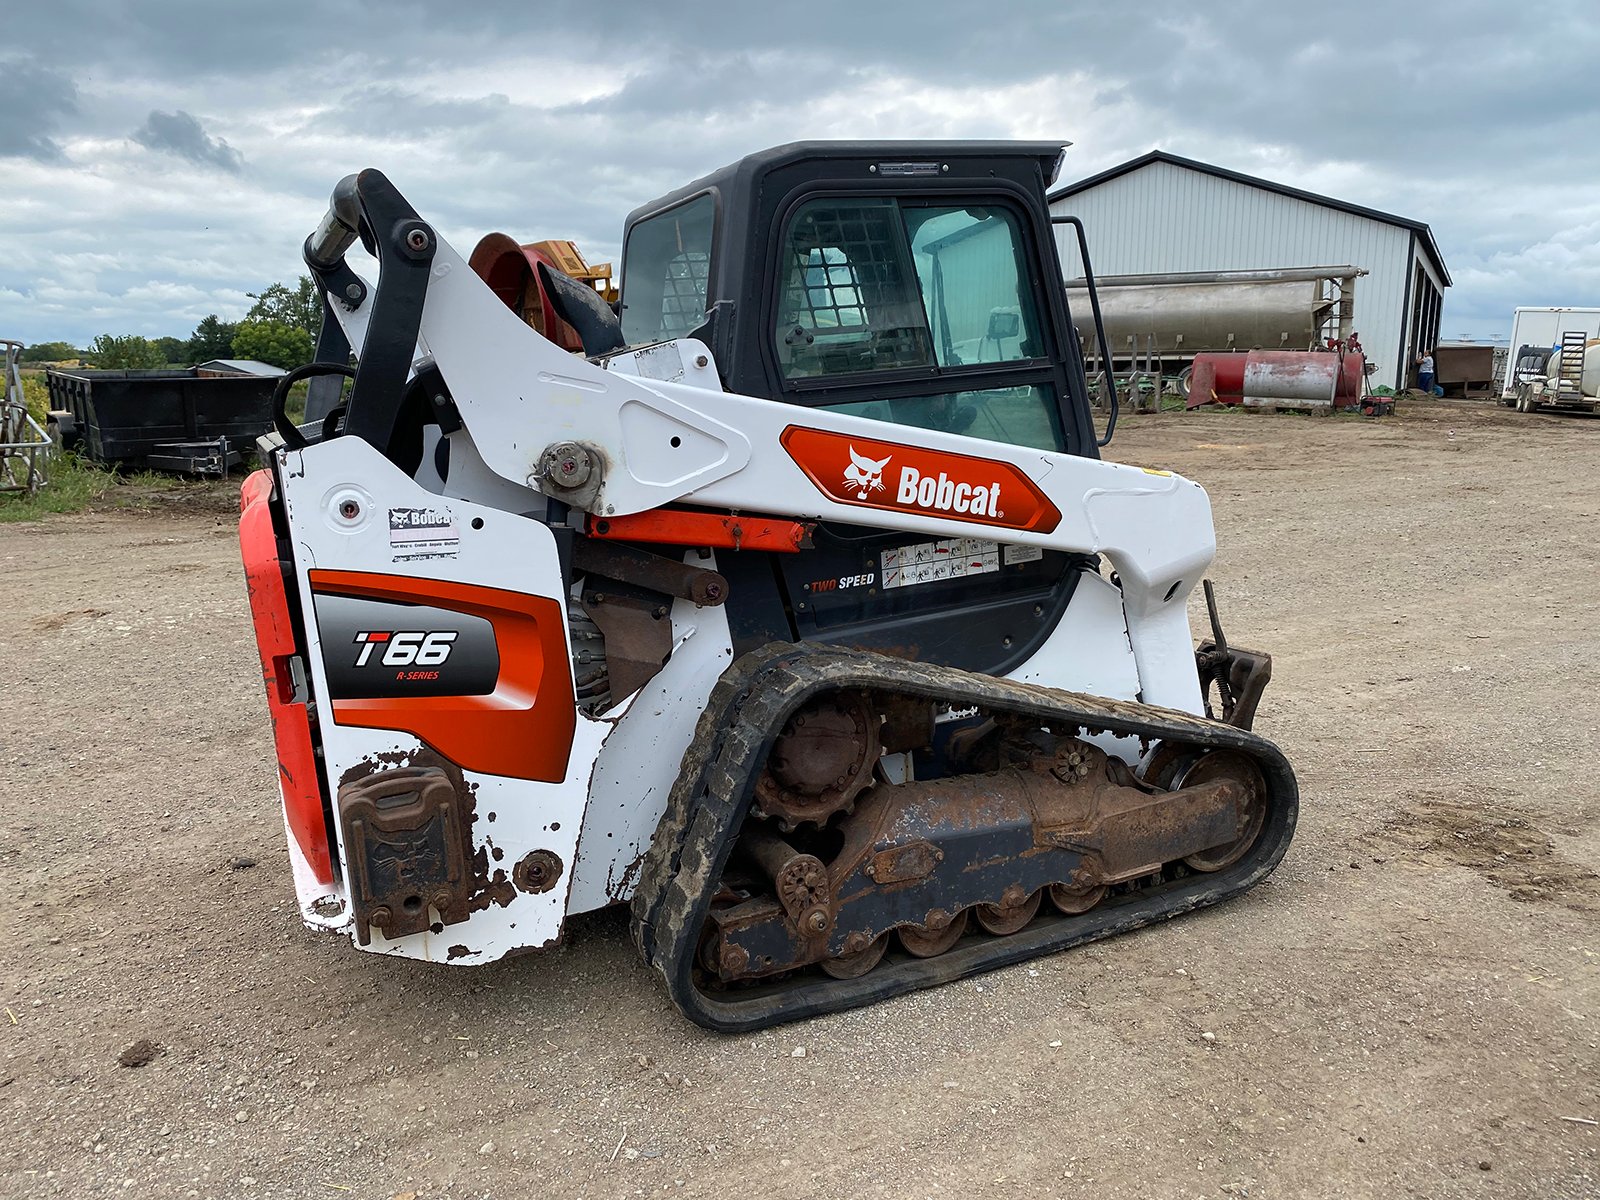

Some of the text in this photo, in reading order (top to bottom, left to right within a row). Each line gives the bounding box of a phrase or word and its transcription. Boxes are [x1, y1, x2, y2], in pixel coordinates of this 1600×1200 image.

[896, 466, 1001, 517] Bobcat
[811, 573, 875, 592] TWO SPEED
[353, 631, 459, 668] T66
[396, 671, 439, 680] R-SERIES
